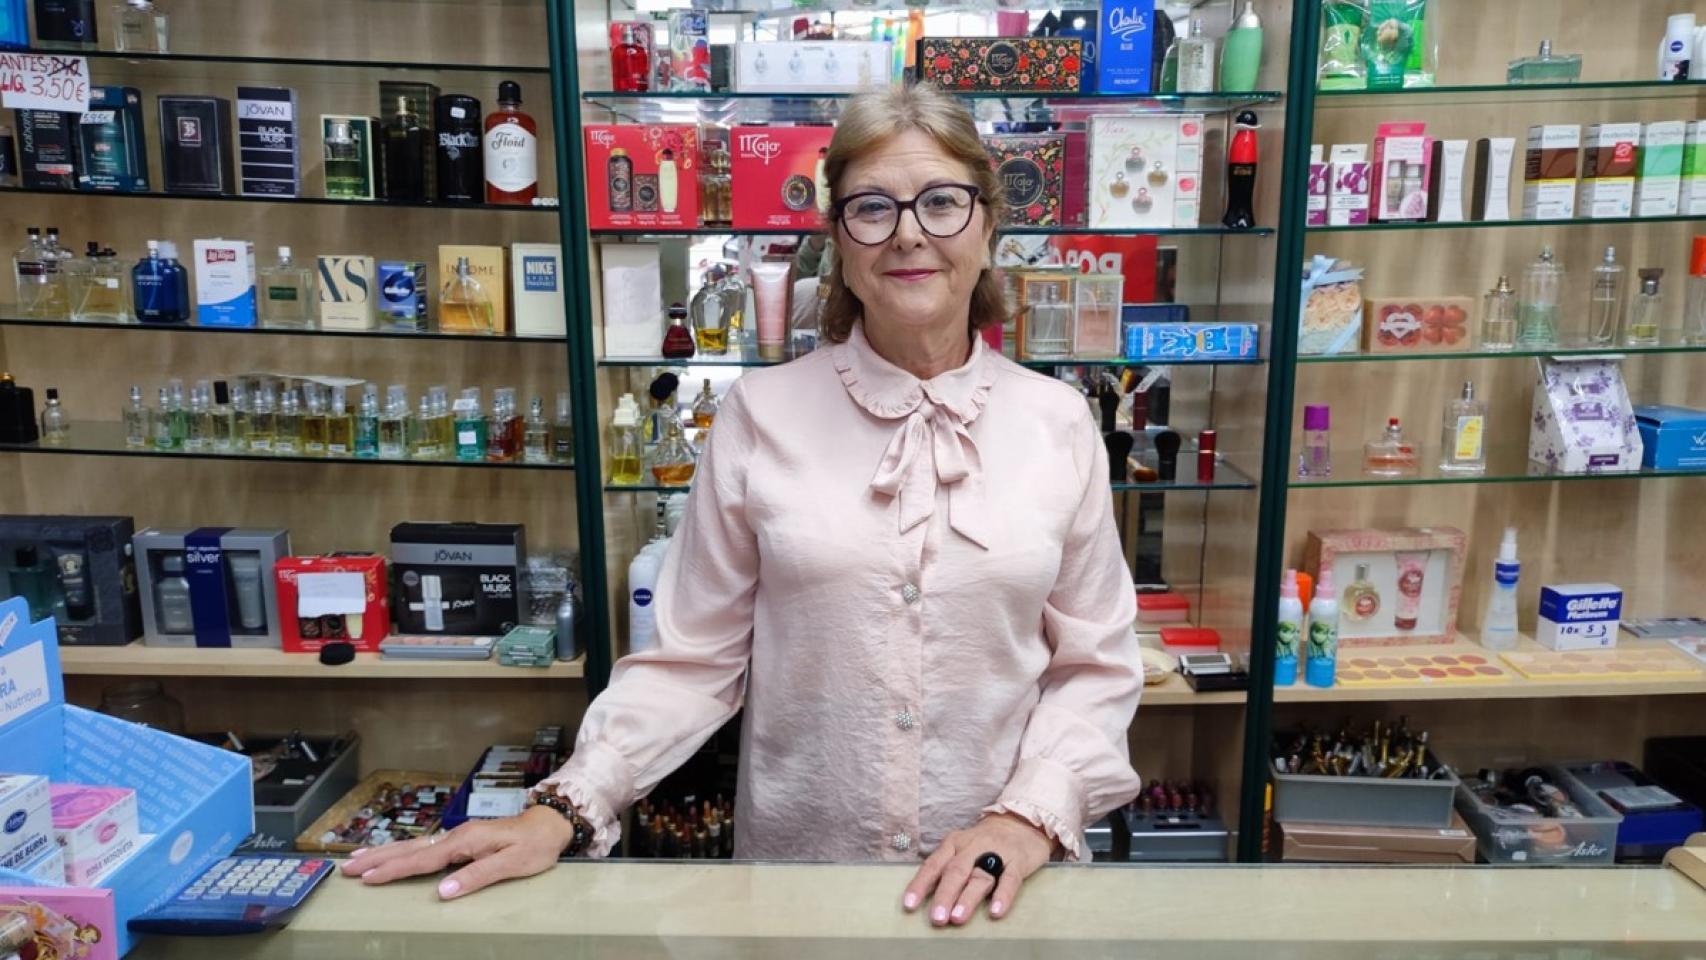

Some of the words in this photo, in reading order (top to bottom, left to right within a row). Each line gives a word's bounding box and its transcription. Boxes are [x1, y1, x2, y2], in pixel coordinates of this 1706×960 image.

[526, 261, 554, 275] NIKE
[317, 257, 368, 303] XS
[186, 551, 219, 563] silver
[1566, 597, 1618, 611] Gillette
